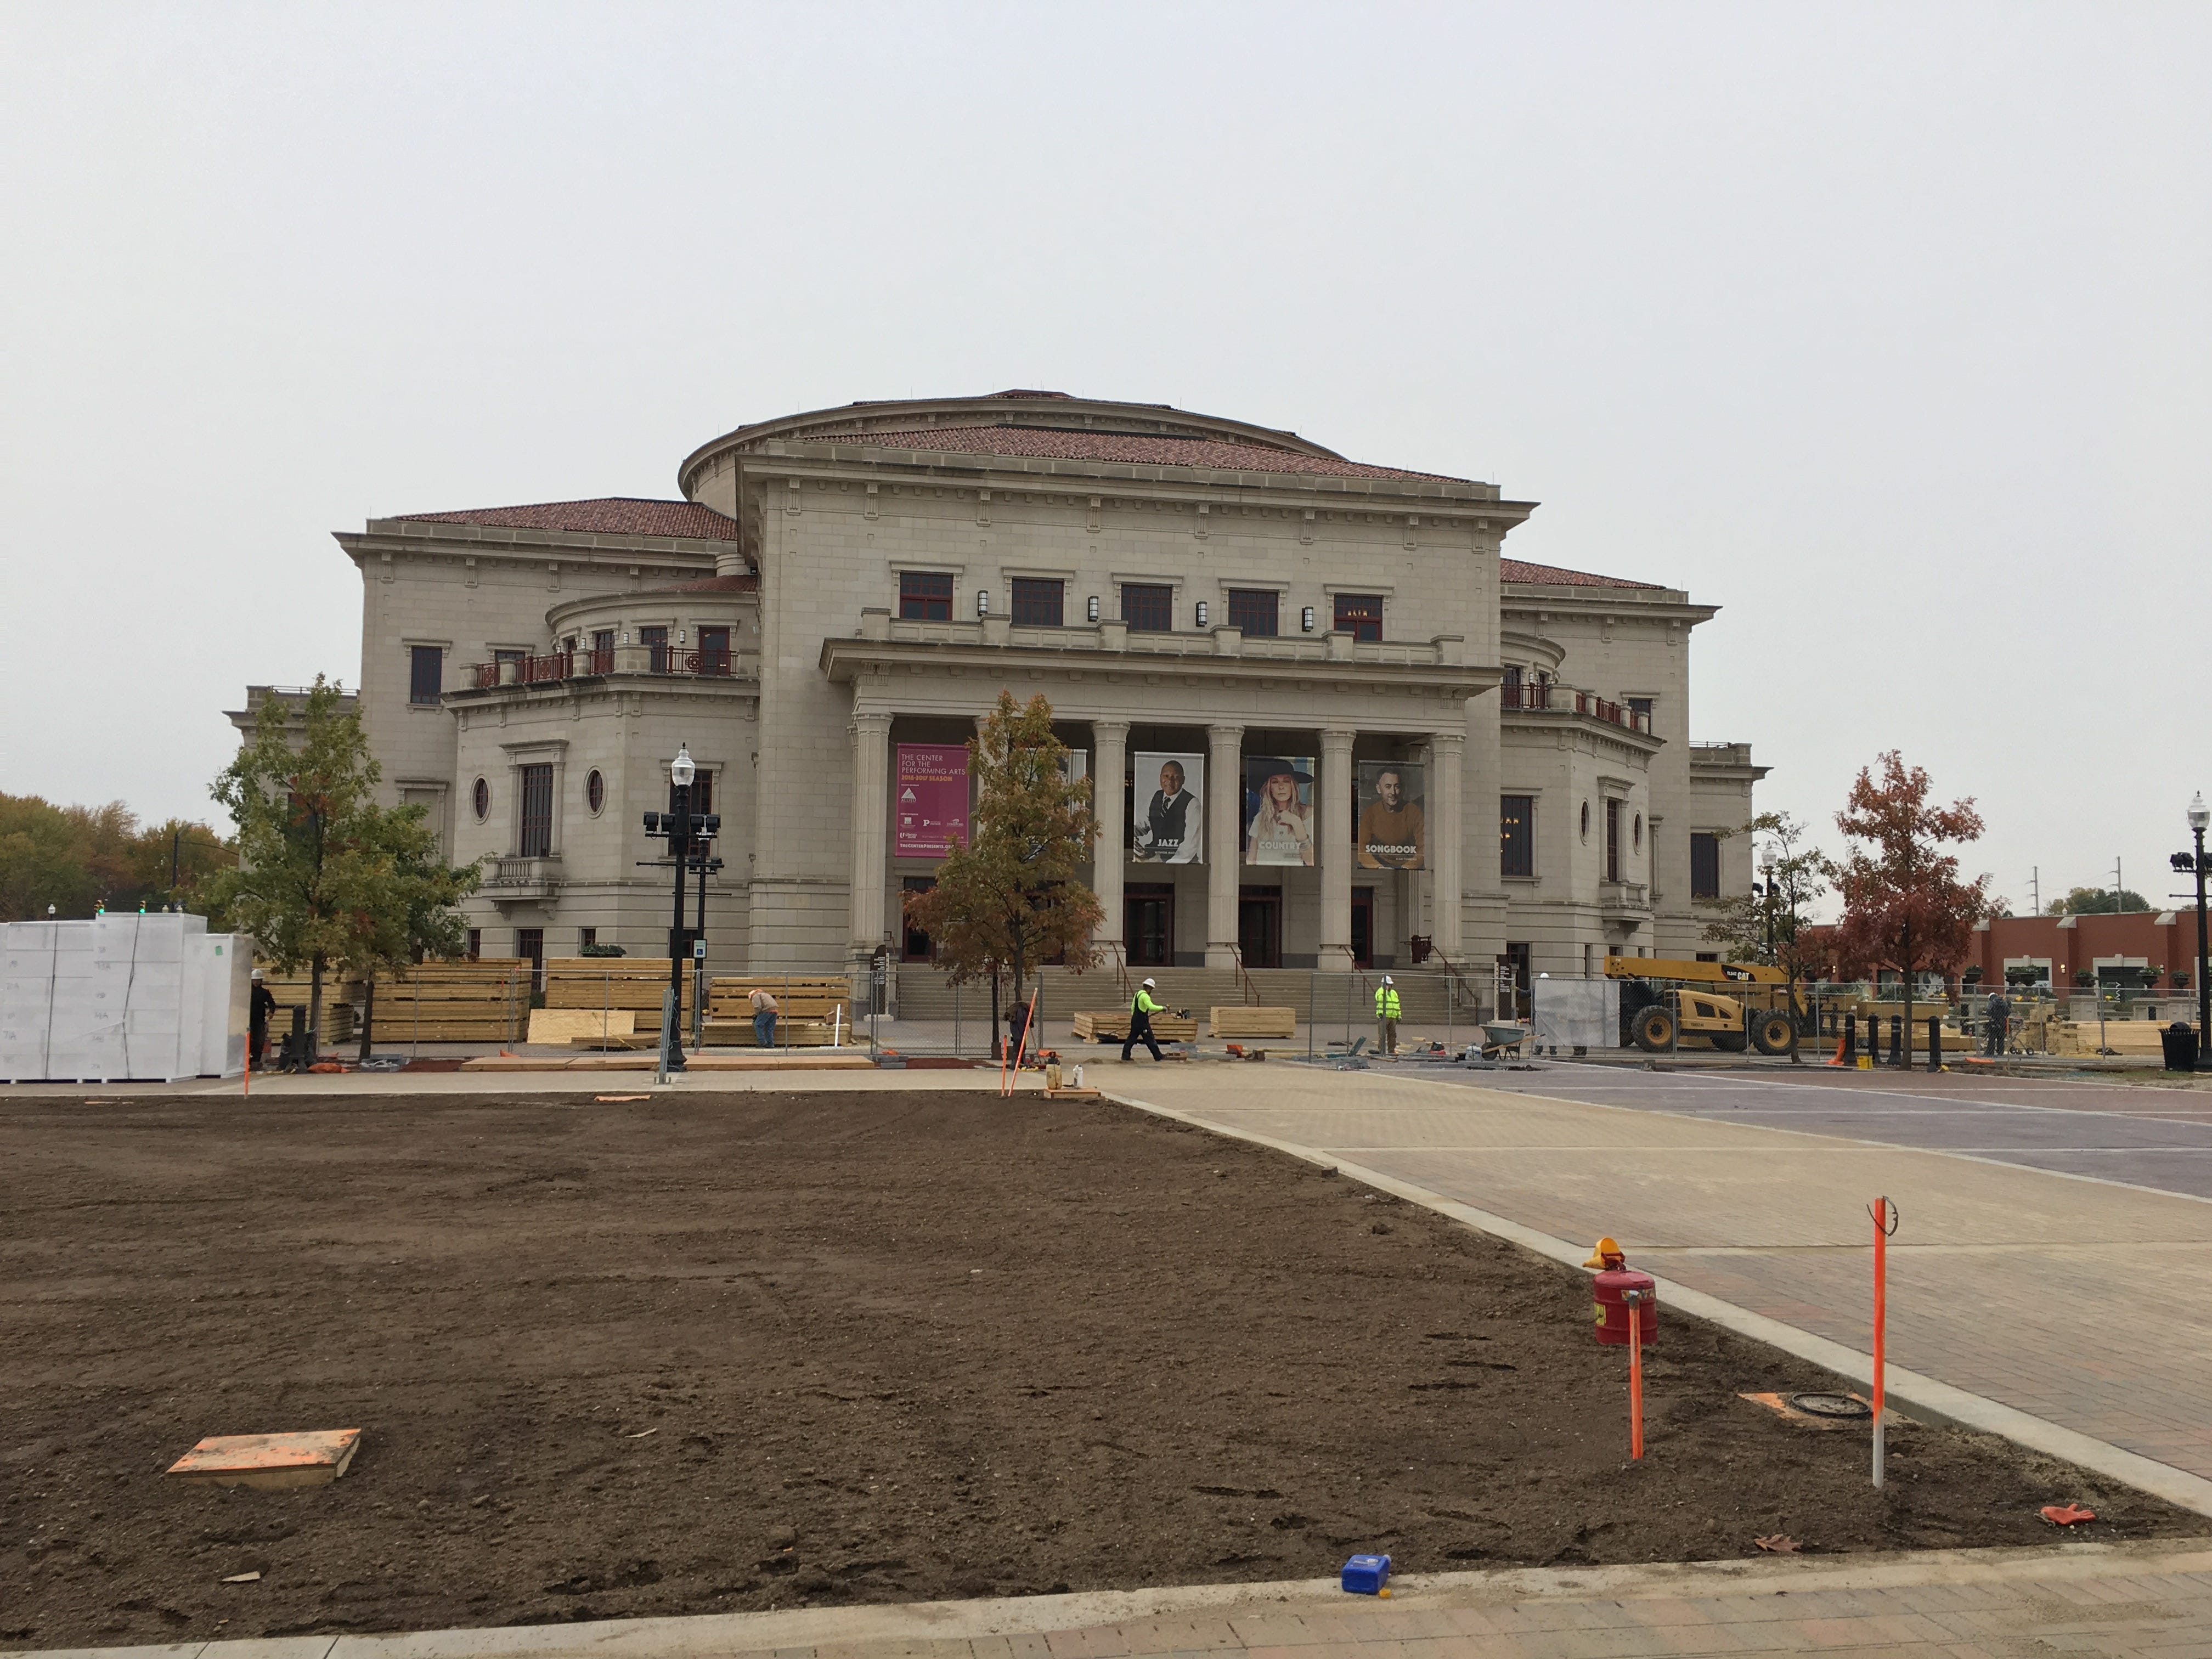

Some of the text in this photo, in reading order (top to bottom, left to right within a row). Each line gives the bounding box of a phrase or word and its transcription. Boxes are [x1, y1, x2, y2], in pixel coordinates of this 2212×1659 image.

[1157, 839, 1179, 847] JAZZ
[1259, 842, 1301, 850] COUNTRY
[1365, 844, 1417, 854] SONGBOOK
[1737, 972, 1750, 981] CAT
